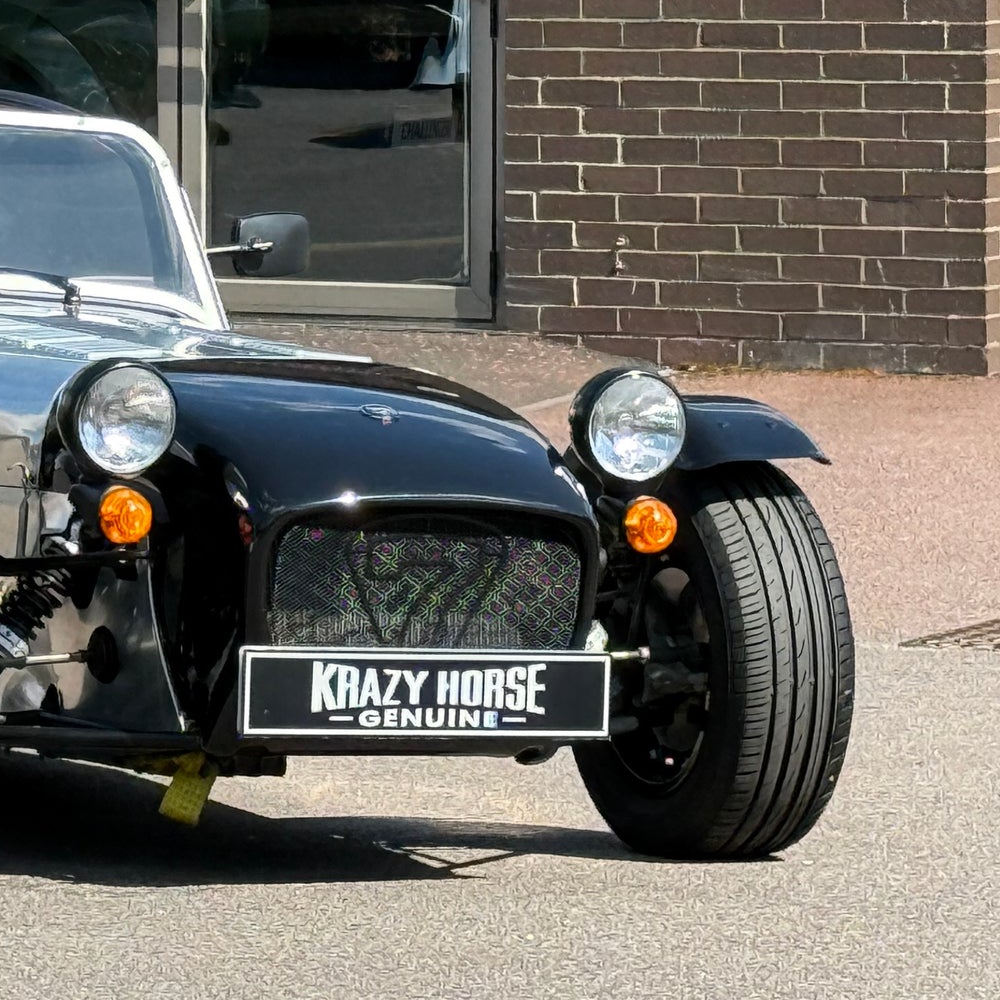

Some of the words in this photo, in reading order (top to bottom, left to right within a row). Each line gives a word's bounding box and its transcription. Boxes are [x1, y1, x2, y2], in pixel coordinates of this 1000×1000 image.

[310, 660, 429, 714] KRAZY
[436, 662, 547, 715] HORSE
[358, 708, 499, 728] GENUINE
